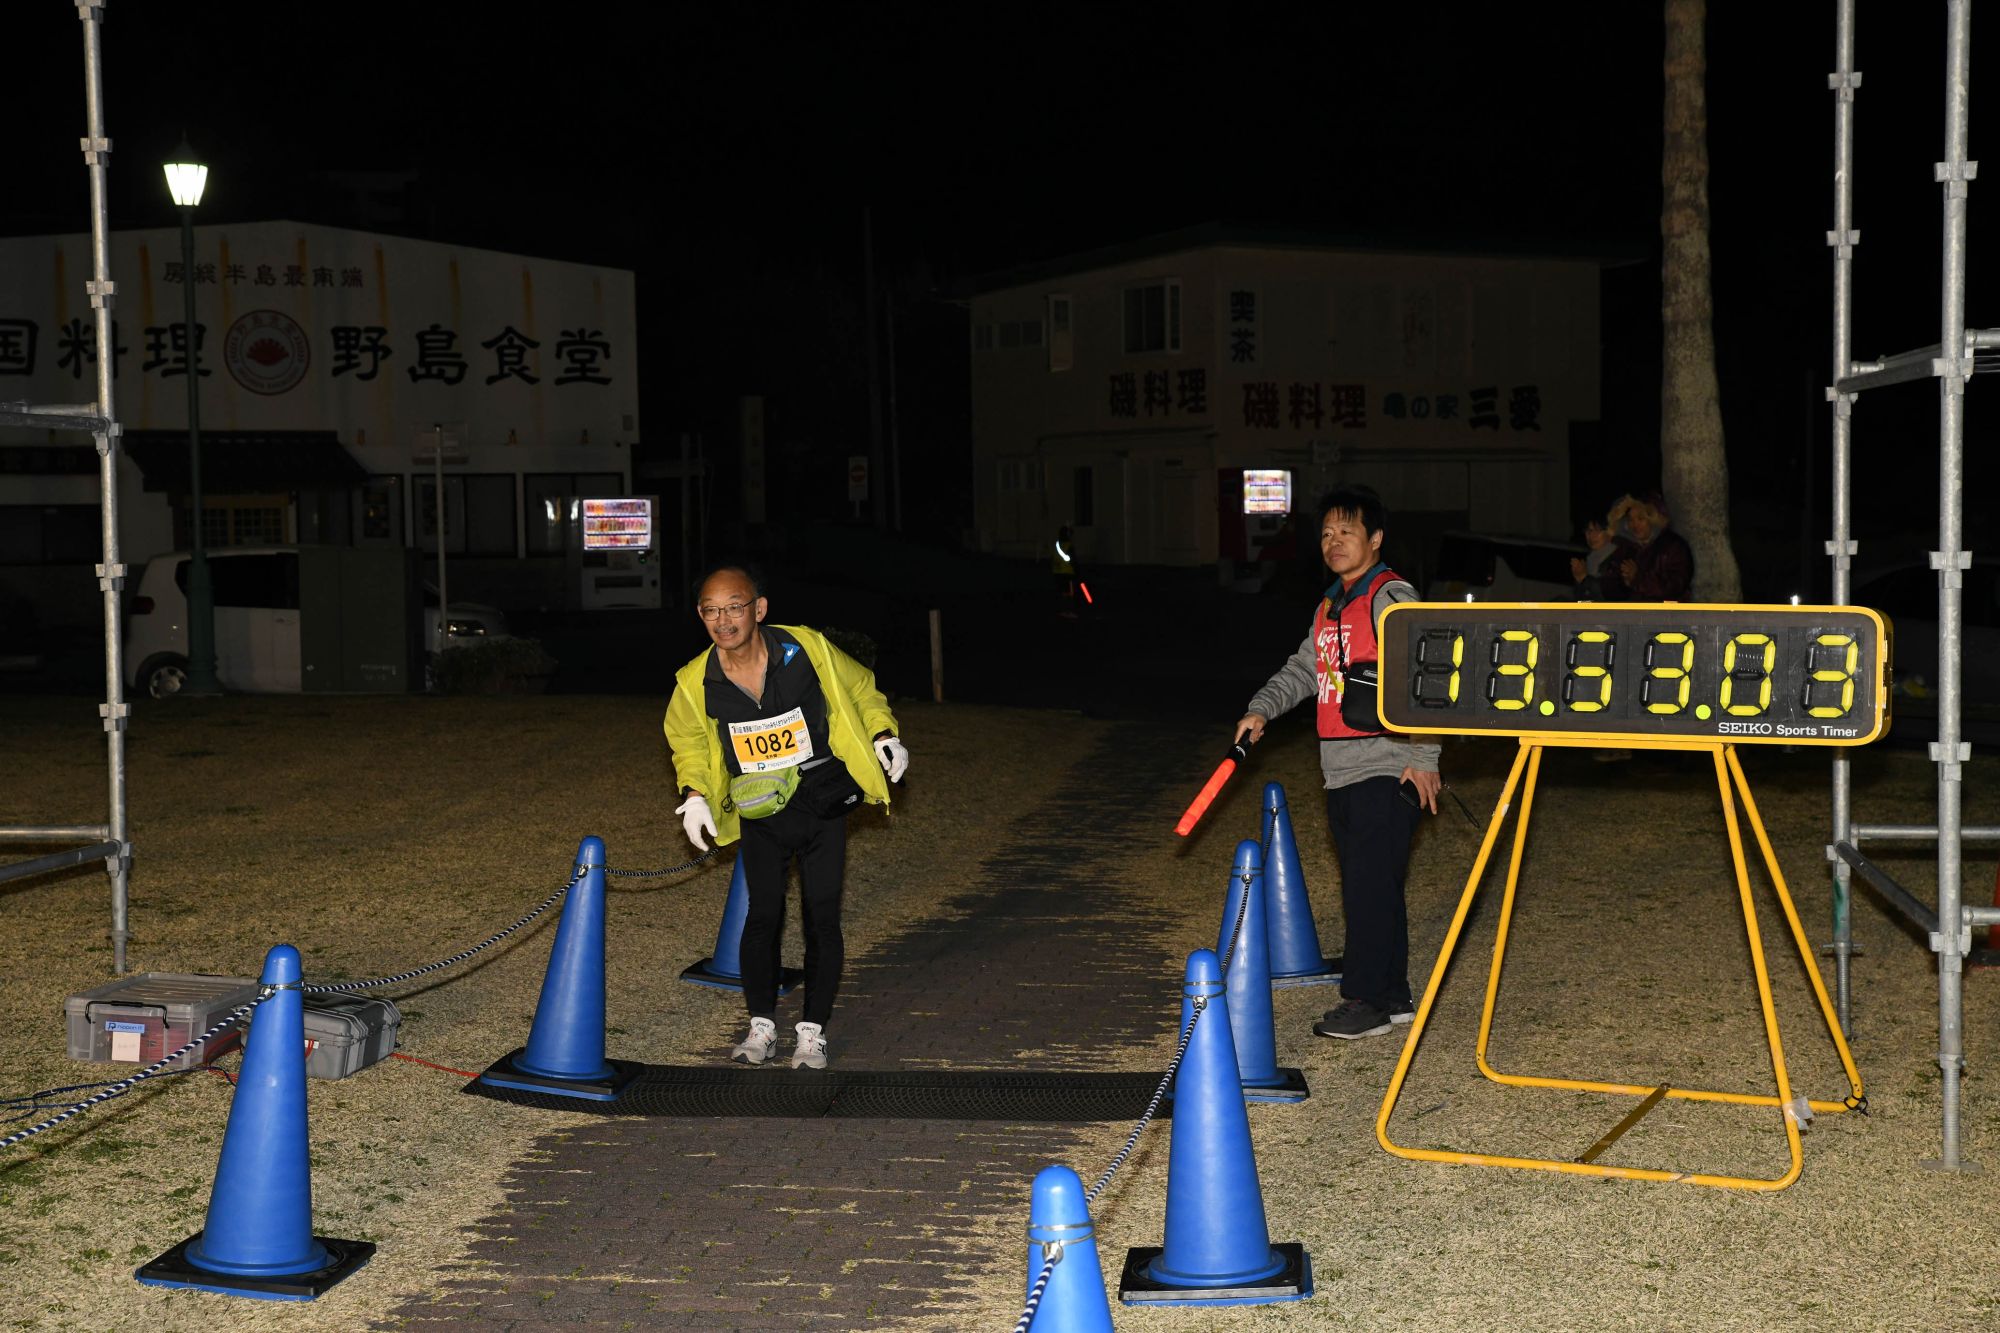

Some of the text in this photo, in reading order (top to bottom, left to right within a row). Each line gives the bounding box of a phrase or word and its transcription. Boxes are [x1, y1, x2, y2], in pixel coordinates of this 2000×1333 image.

[331, 322, 613, 386] 野島食堂
[1108, 367, 1207, 417] 磯料理
[1242, 382, 1367, 430] 磯料理
[744, 729, 796, 756] 1082
[1718, 722, 1858, 737] SEIKO Sports Timer
